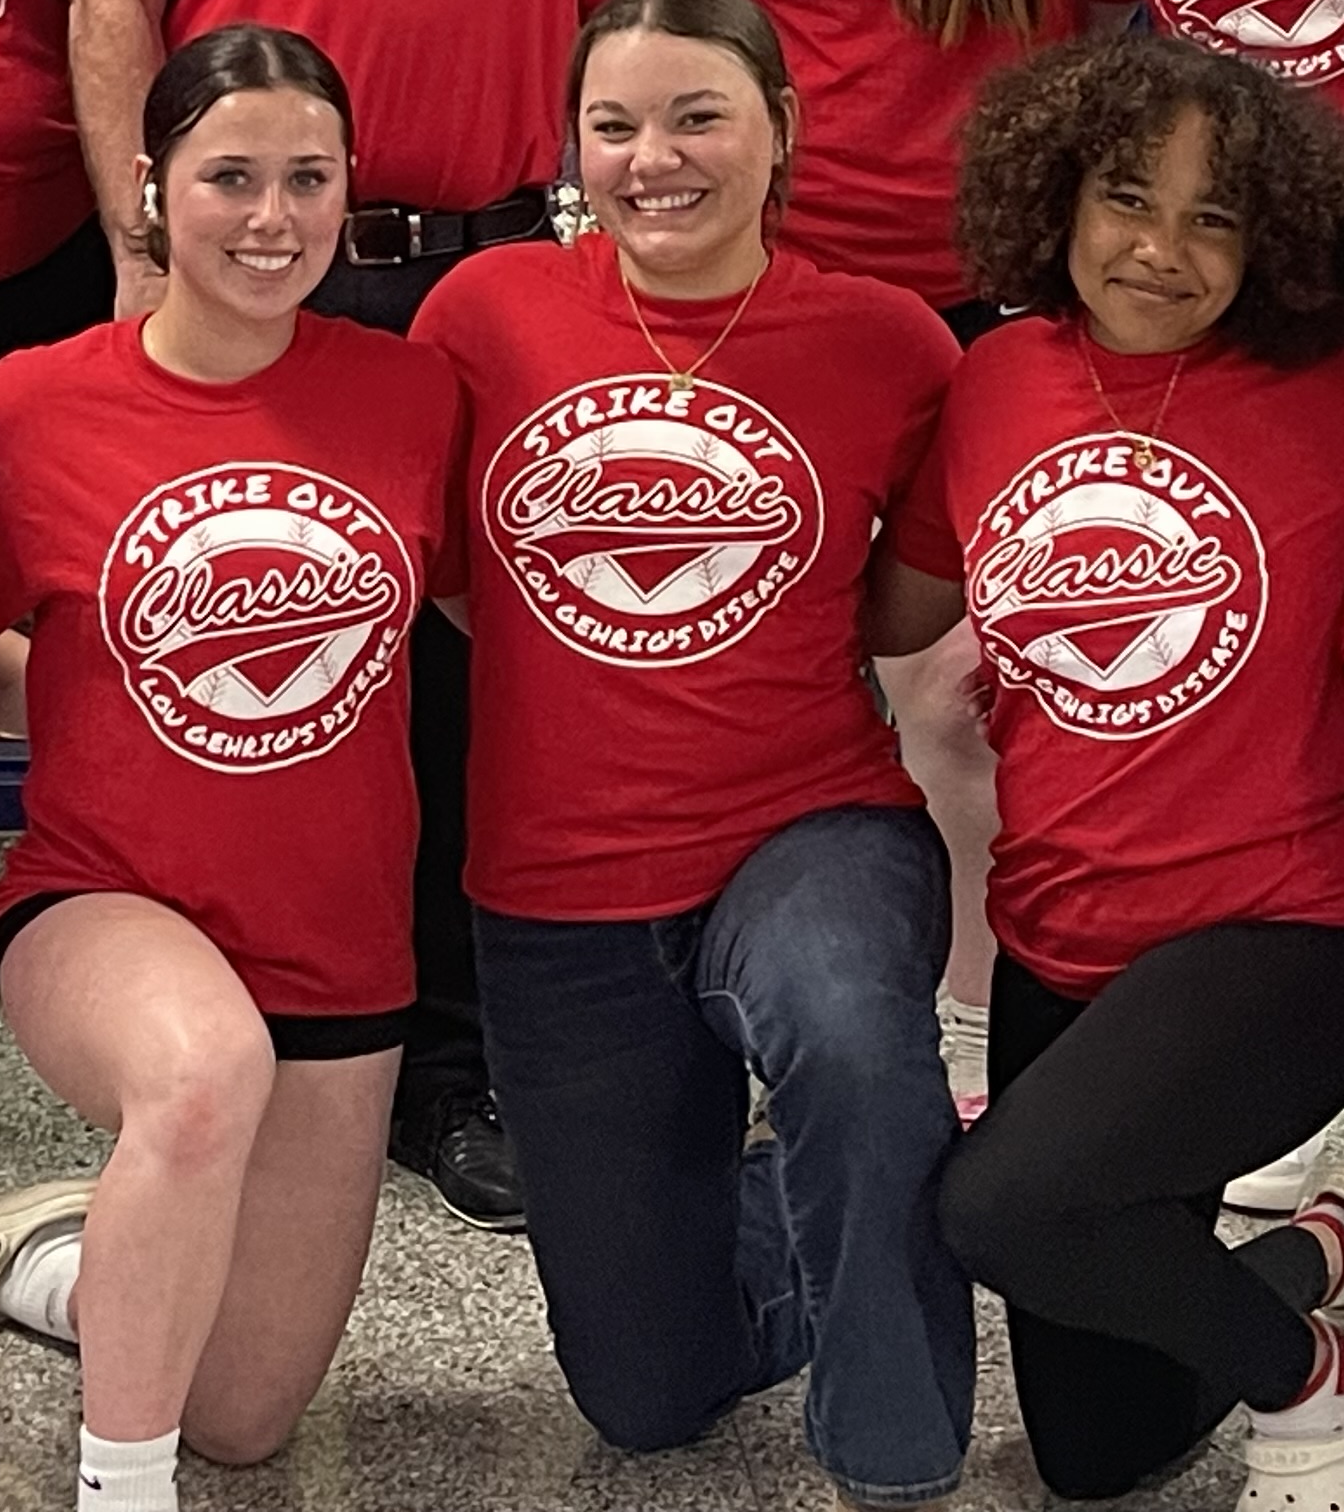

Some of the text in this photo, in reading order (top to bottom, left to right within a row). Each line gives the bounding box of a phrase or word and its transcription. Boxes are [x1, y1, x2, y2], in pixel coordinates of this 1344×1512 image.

[522, 385, 794, 464] STRIKE OUT
[124, 473, 382, 570] STRIKE OUT
[498, 456, 784, 536] Classic
[989, 445, 1232, 537] STRIKE OUT
[119, 552, 382, 655] Classic
[514, 550, 800, 655] LOU GEHRIG'S DISEASE
[968, 536, 1221, 617] Classic
[1158, 608, 1250, 714] DISEASE
[139, 676, 189, 728] LOU
[183, 721, 318, 759] GEHRIG'S
